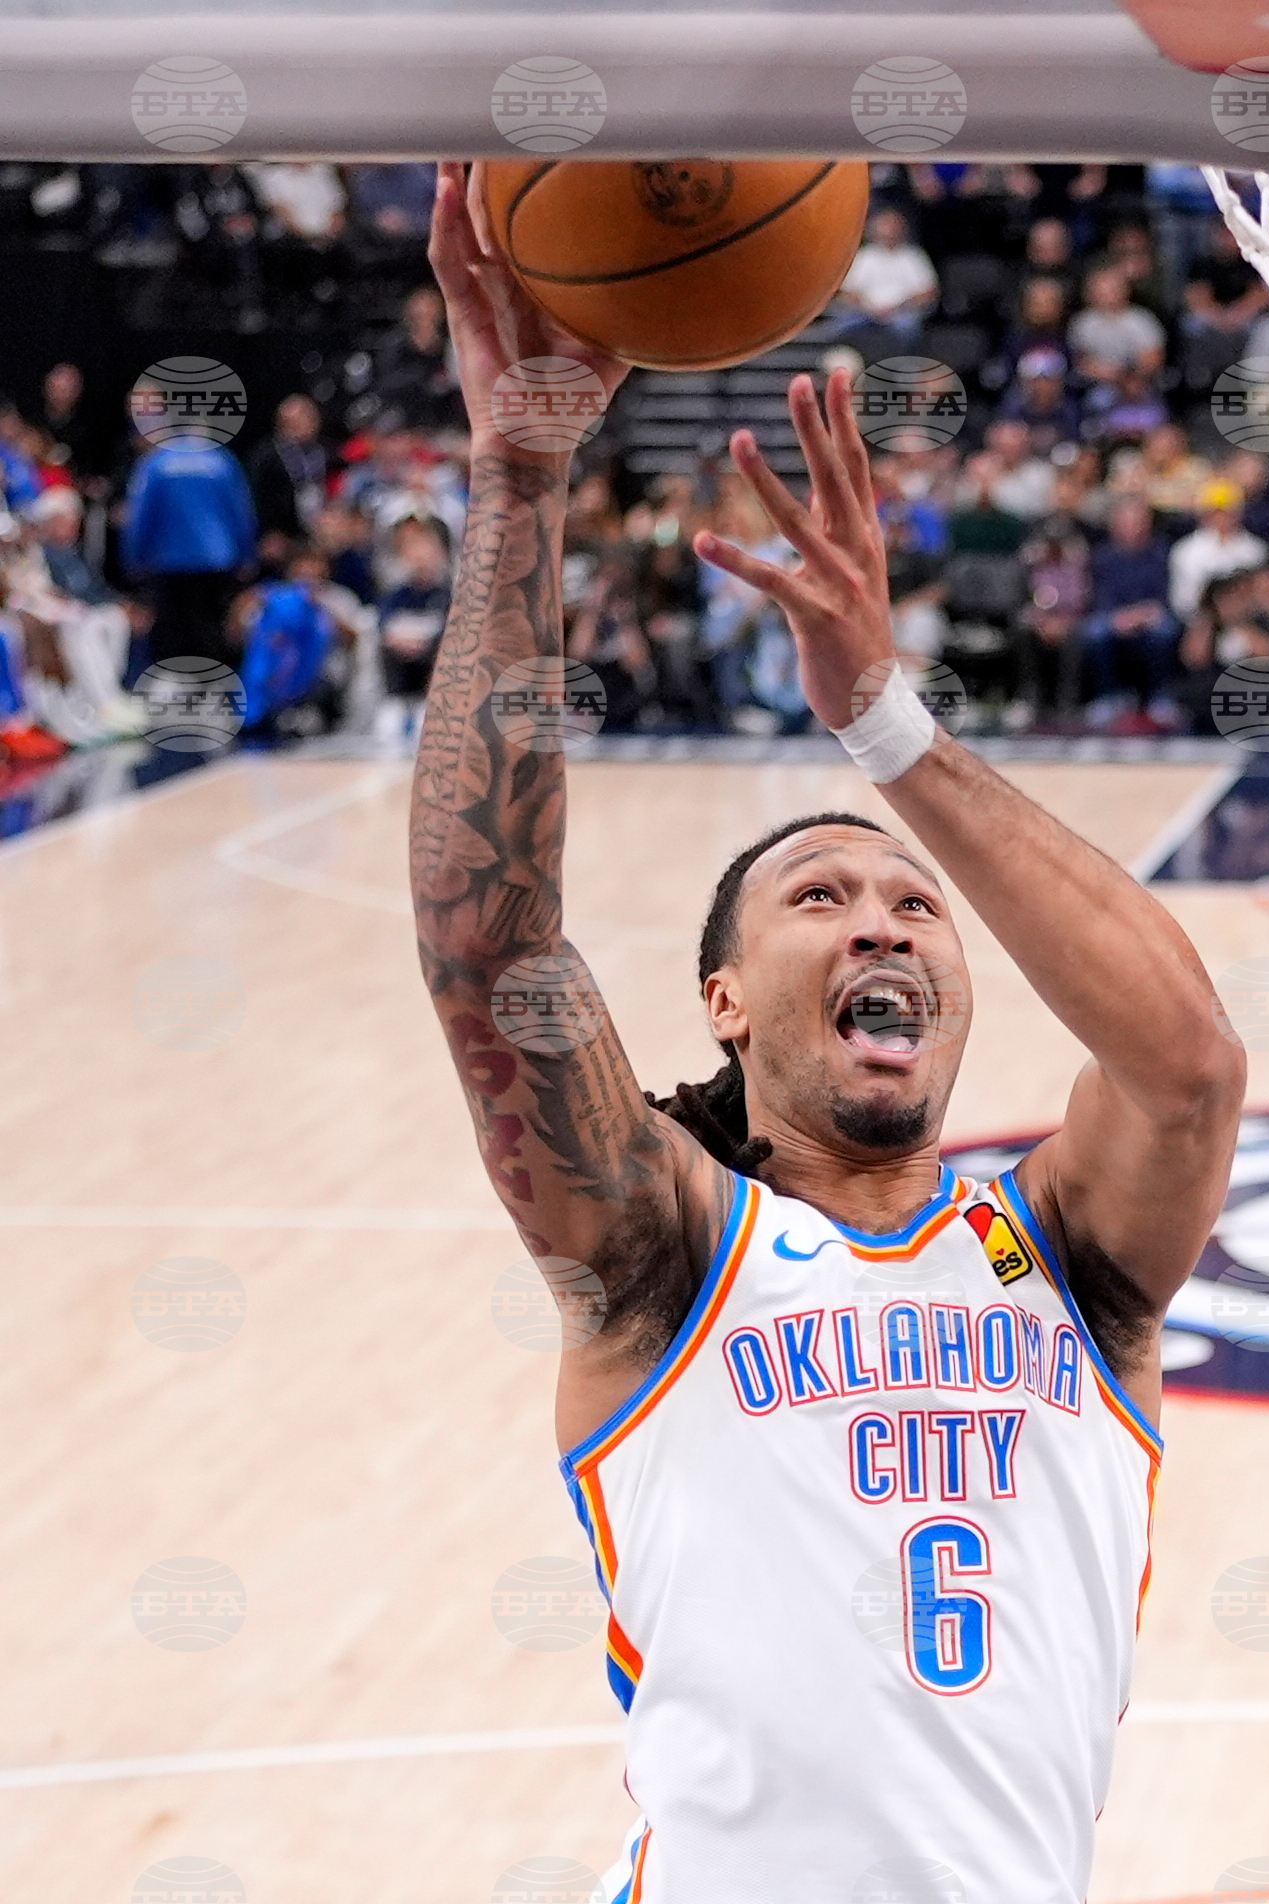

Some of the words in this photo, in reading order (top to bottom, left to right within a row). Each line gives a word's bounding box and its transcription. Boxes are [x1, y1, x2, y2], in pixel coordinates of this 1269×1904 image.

[722, 1300, 1083, 1417] OKLAHOMA
[849, 1410, 1026, 1504] CITY
[900, 1515, 992, 1697] 6
